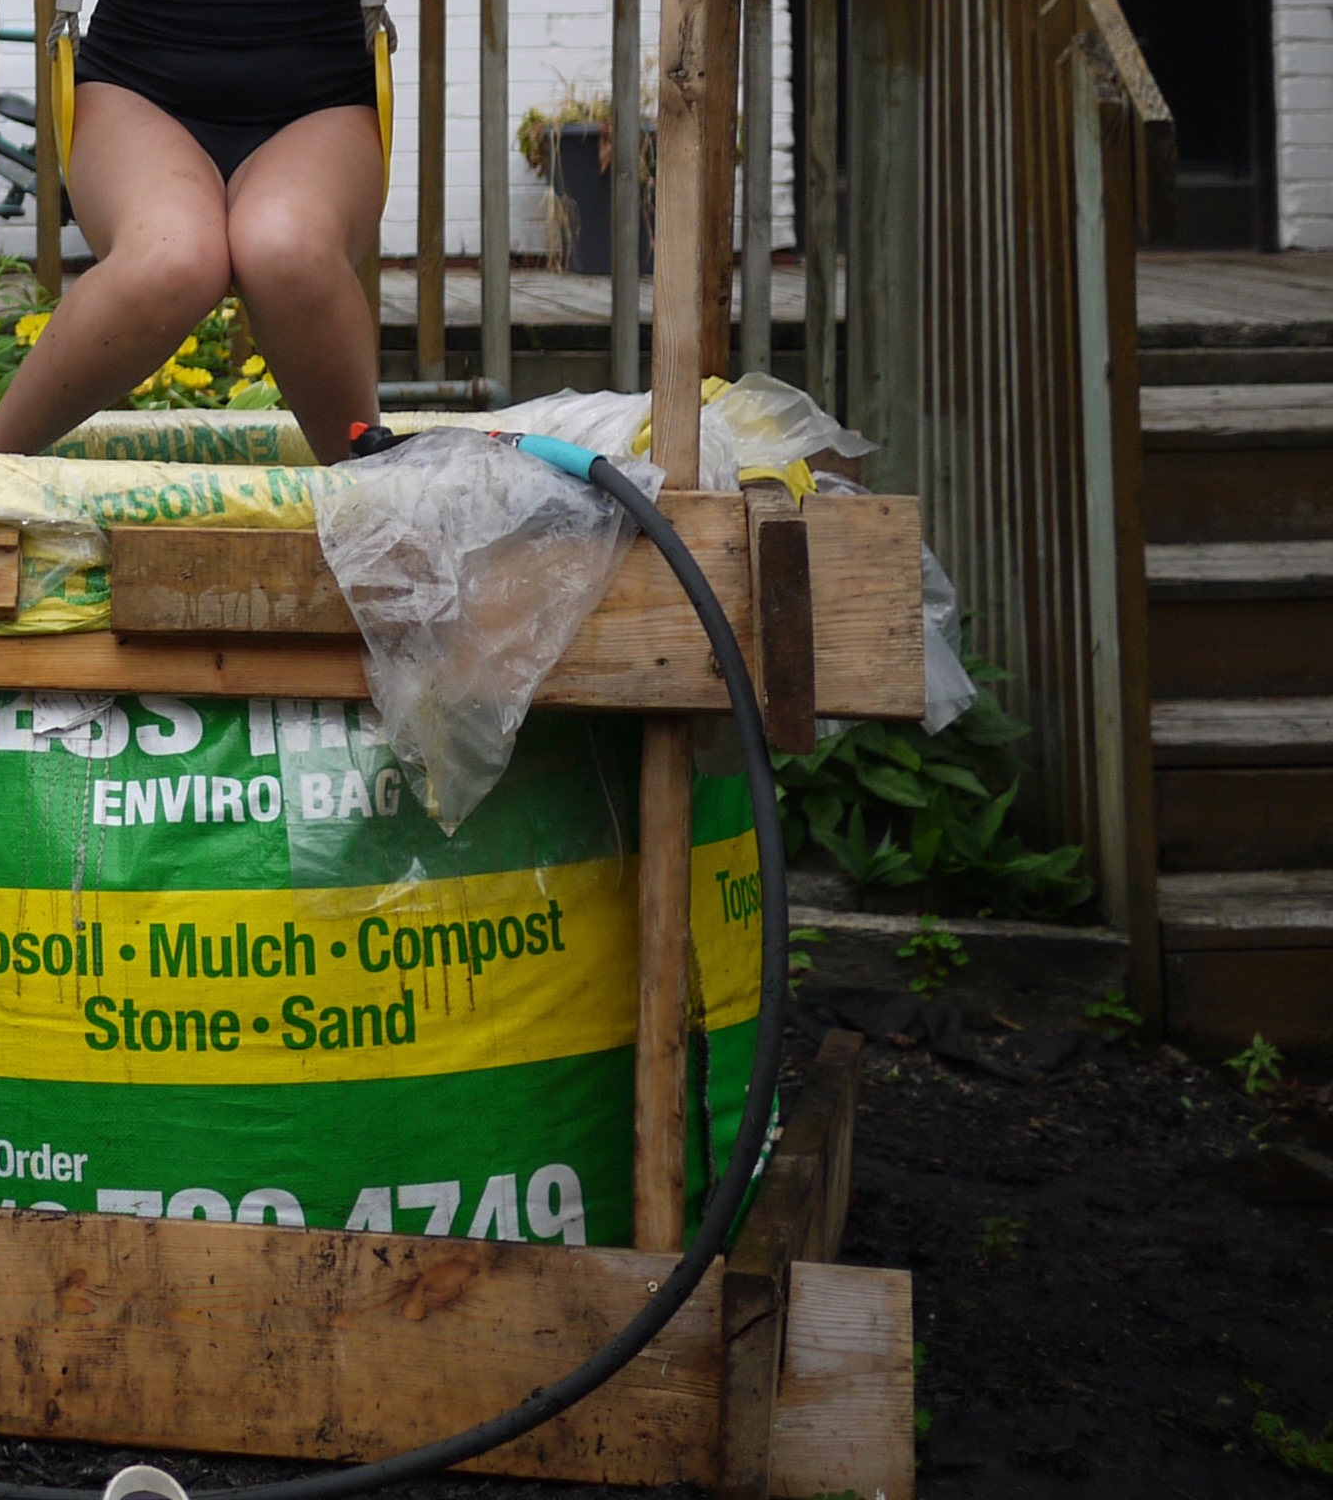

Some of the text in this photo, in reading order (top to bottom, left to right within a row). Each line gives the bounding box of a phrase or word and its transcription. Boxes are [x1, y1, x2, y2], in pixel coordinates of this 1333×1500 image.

[93, 768, 400, 826] ENVIRO BAG
[149, 921, 316, 979] Mulch
[357, 899, 566, 976] Compost
[84, 990, 416, 1053] Stone Sand
